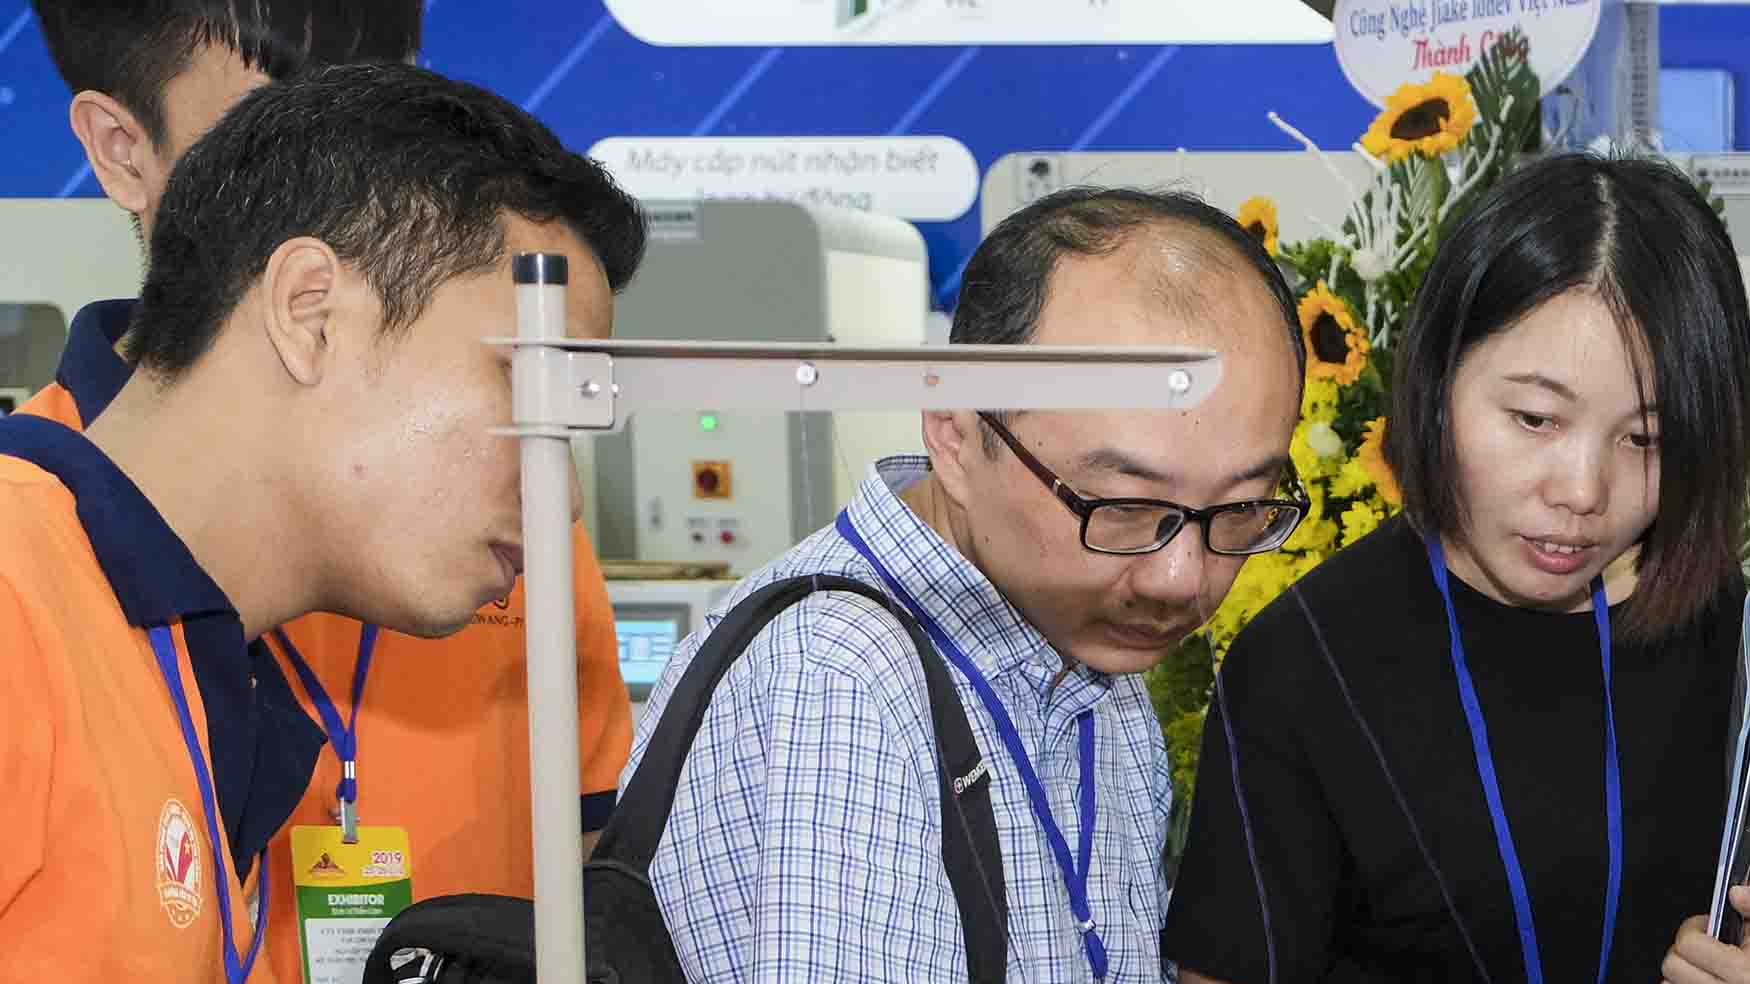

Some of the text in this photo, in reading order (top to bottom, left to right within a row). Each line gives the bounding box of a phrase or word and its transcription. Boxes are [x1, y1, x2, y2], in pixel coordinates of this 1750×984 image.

[1411, 37, 1471, 71] Thành
[373, 852, 403, 864] 2019
[327, 894, 385, 906] EXHIBITOR
